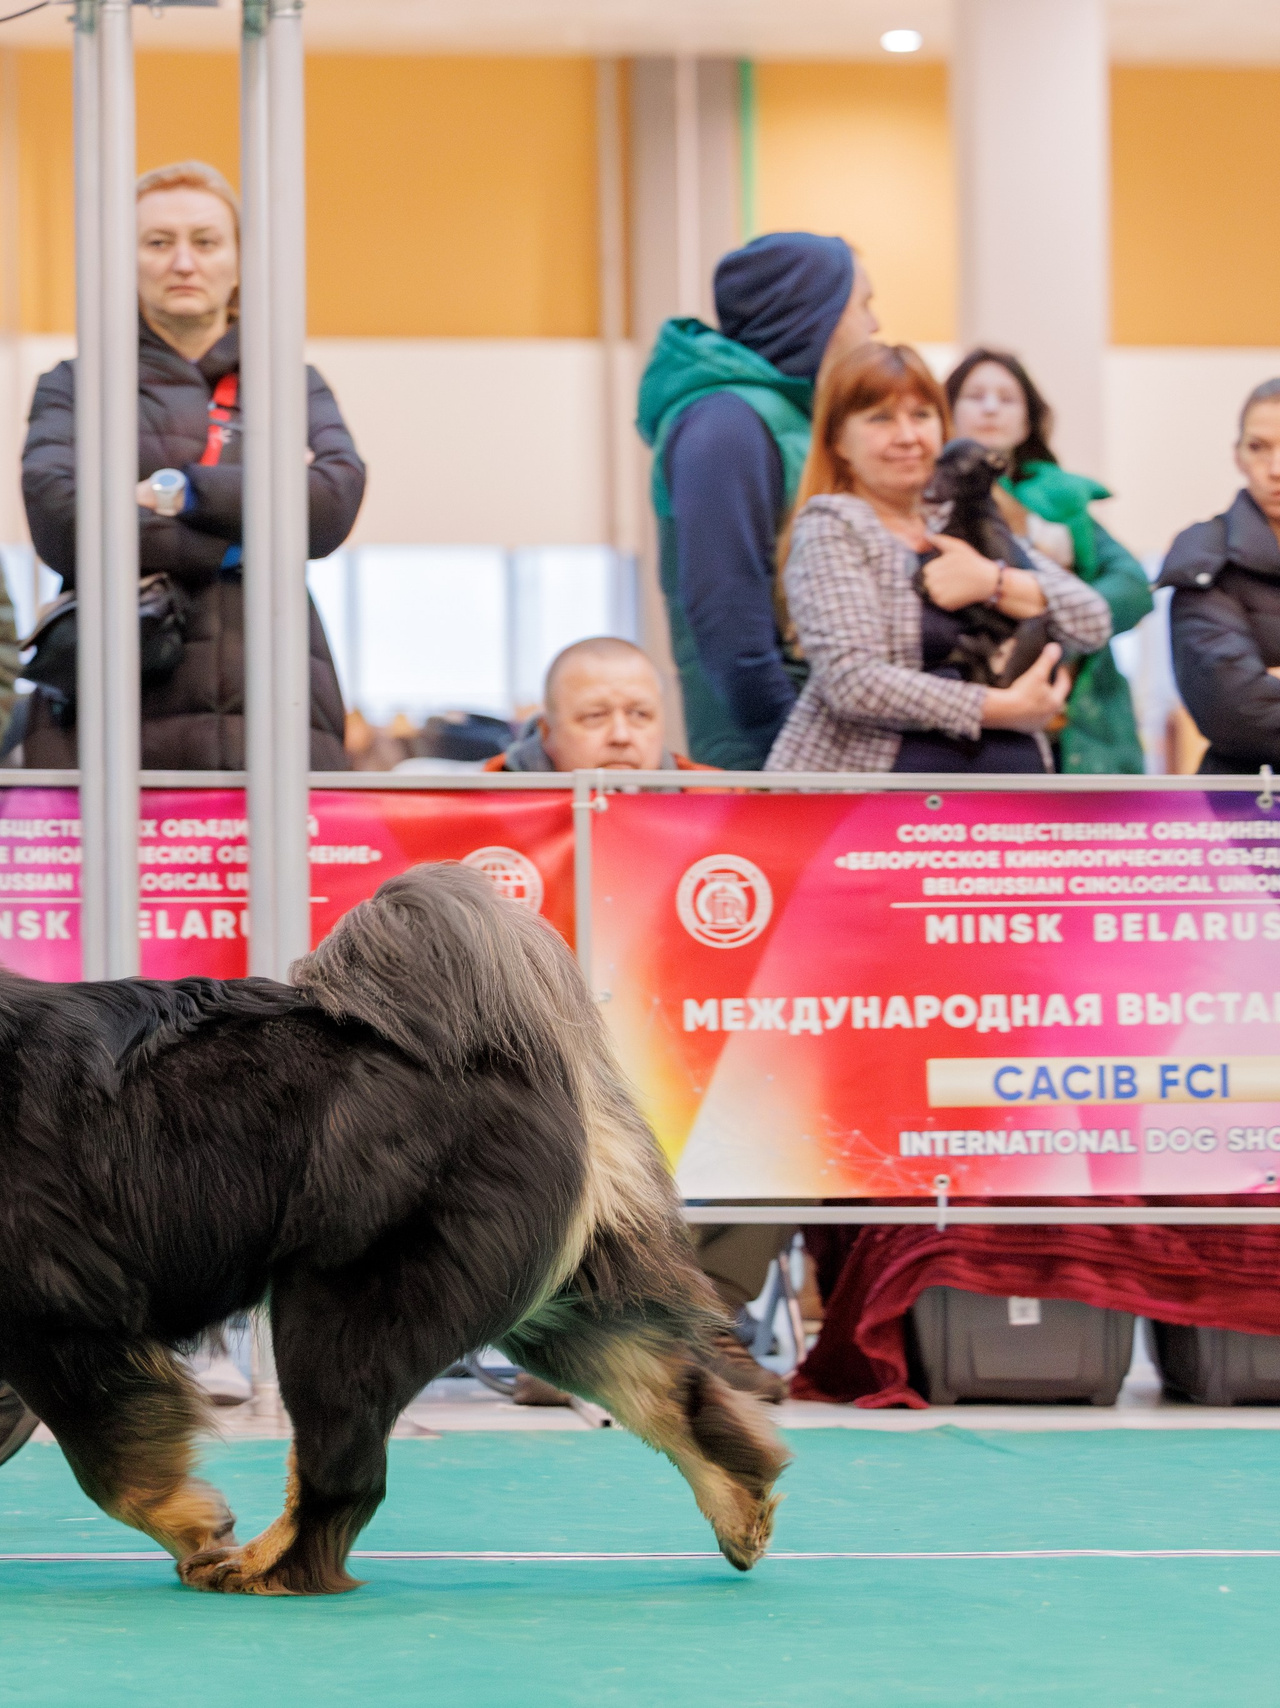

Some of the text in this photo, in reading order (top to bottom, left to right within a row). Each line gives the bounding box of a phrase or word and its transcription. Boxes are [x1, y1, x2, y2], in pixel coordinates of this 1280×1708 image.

[161, 814, 319, 840] ОБЪЕДИЙ
[897, 823, 967, 843] СОЮЗ
[971, 822, 1148, 844] ОБЩЕСТВЕННЫХ
[834, 850, 1001, 870] «БЕЛОРУССКОЕ
[1004, 848, 1203, 868] КИНОЛОГИЧЕСКОЕ
[923, 877, 1065, 896] BELORUSSIAN
[1069, 875, 1213, 894] CINOLOGICAL
[138, 909, 249, 939] ELAR
[925, 911, 1280, 944] MINSK BELARUS
[683, 991, 1280, 1035] МЕЖДУНАРОДНАЯ ВЫСТА
[993, 1063, 1230, 1100] CACIB FCI
[899, 1128, 1139, 1156] INTERNATIONAL
[1145, 1127, 1218, 1154] DOG
